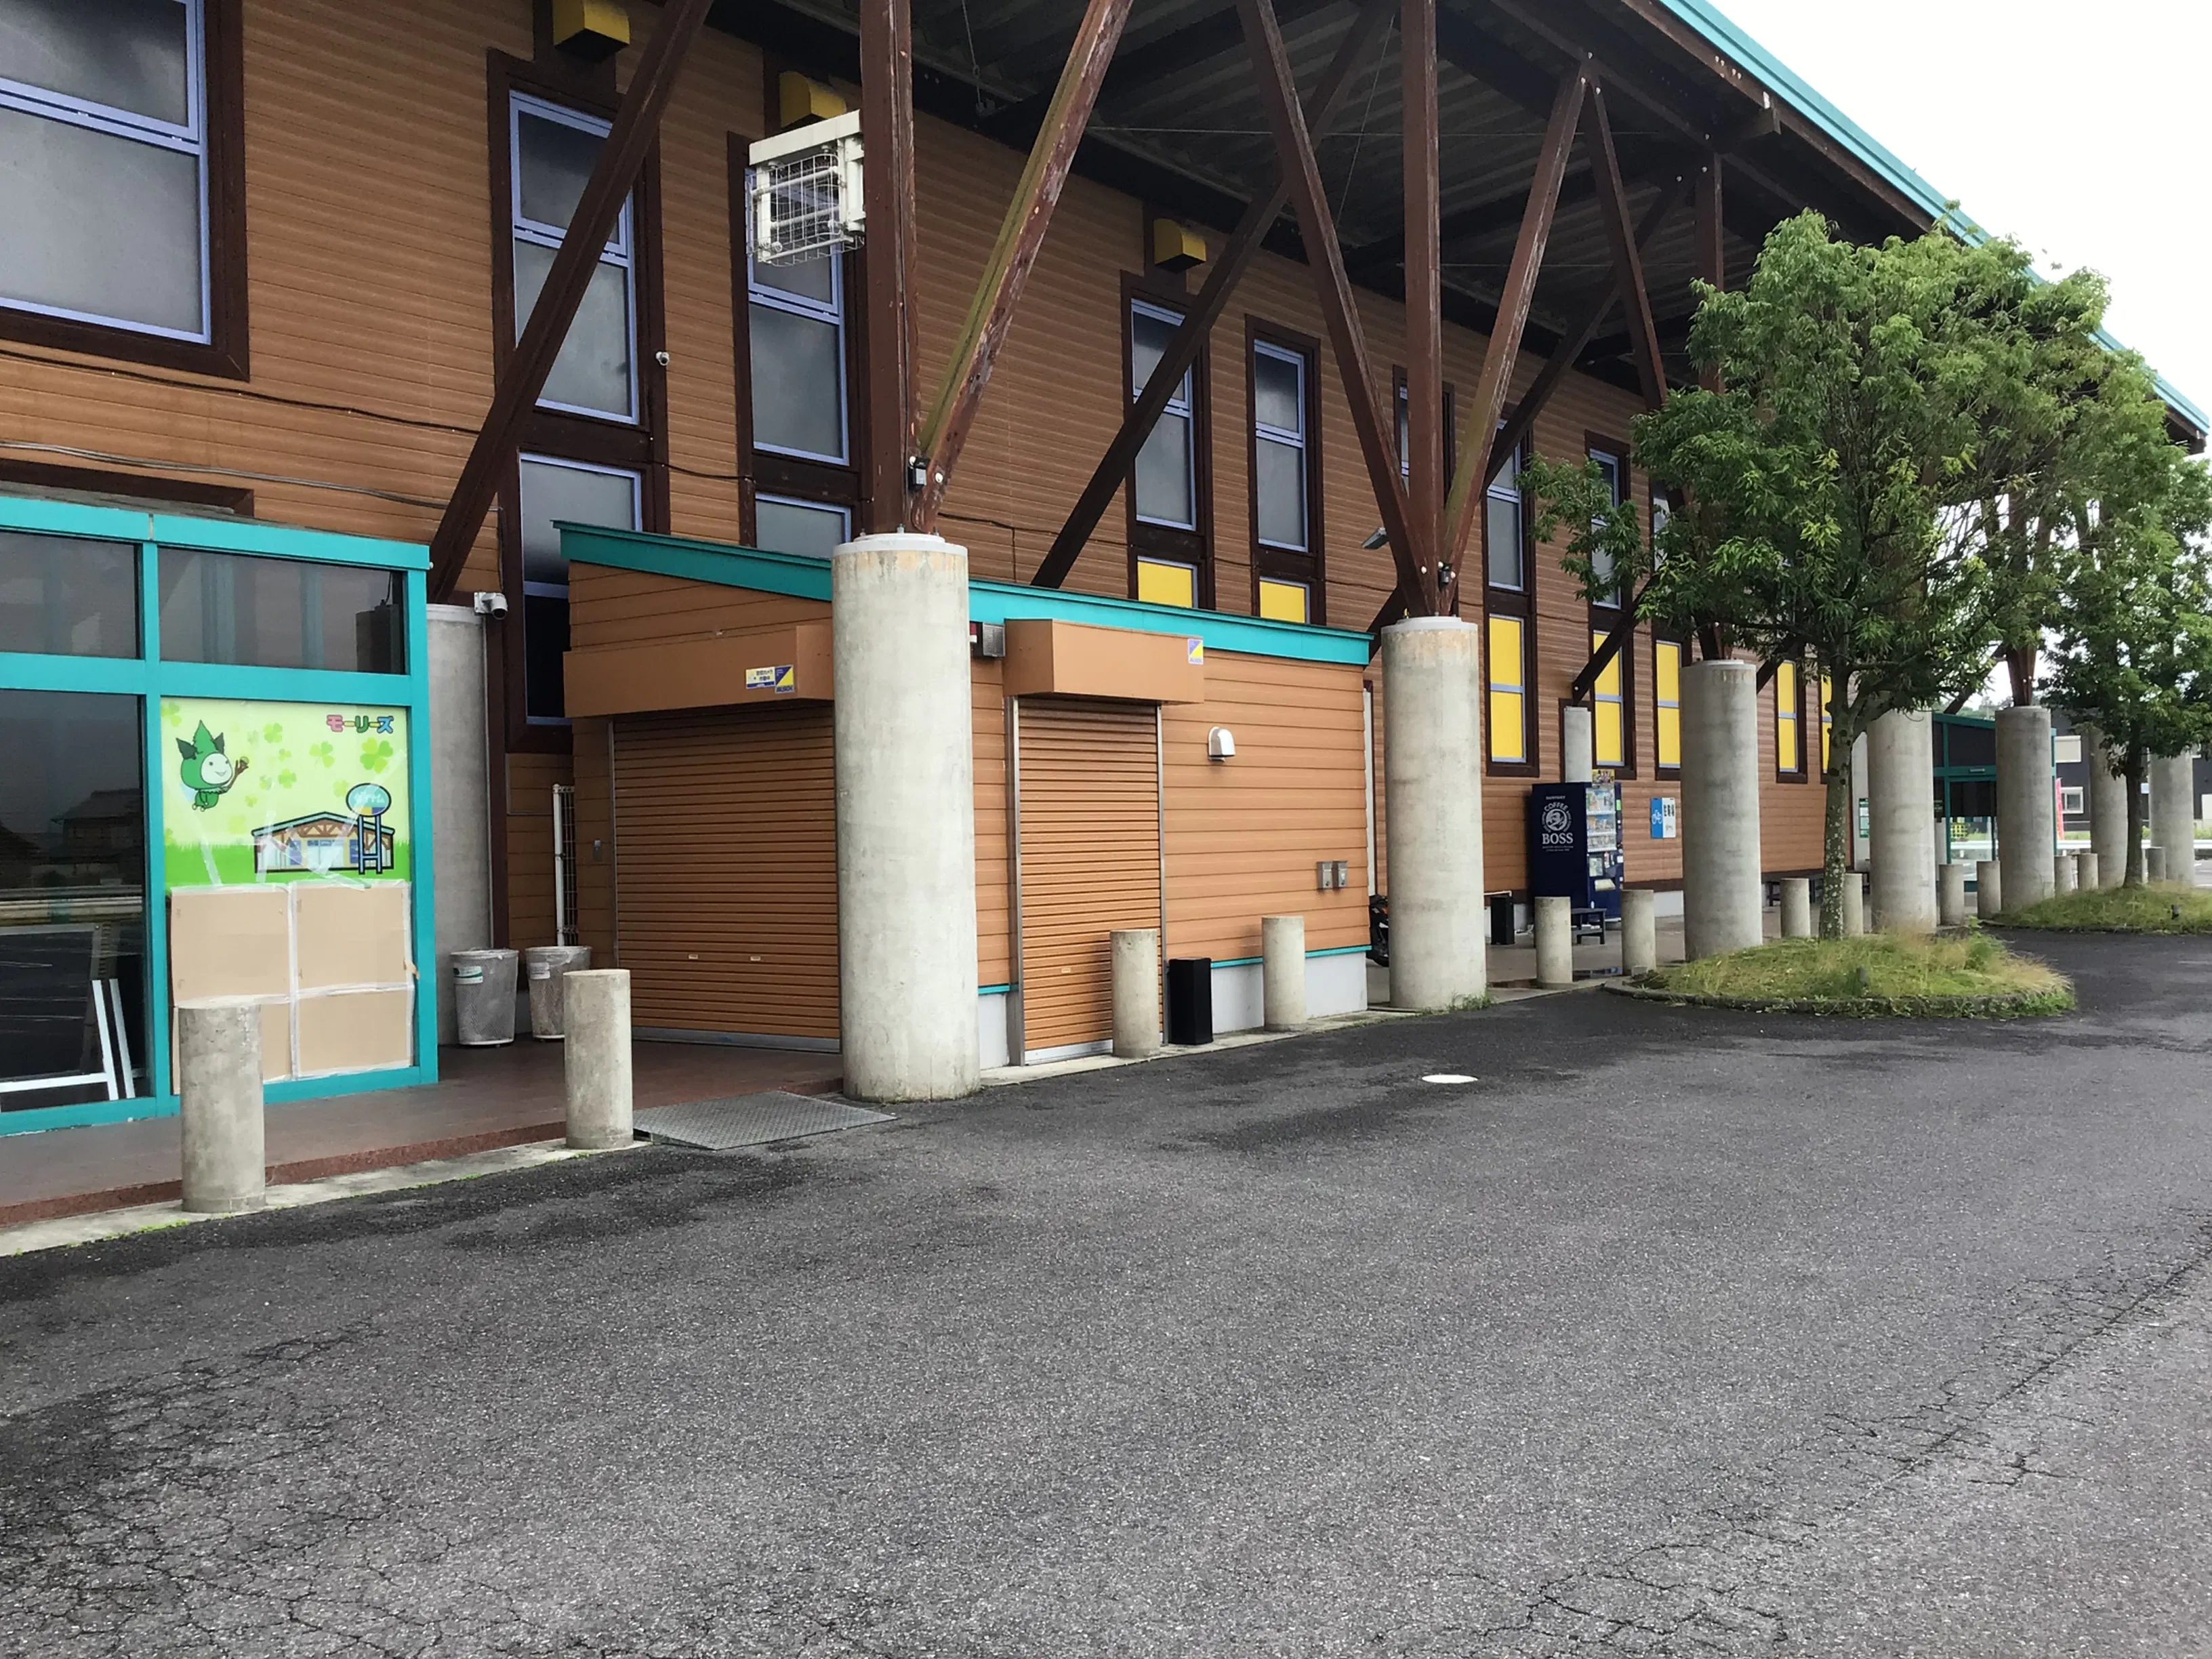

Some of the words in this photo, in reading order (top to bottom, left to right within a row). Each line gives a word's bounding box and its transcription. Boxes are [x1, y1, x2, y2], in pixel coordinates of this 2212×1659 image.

[326, 714, 394, 733] モーリーズ
[1544, 802, 1569, 811] COFFEE
[1542, 833, 1573, 844] BOSS
